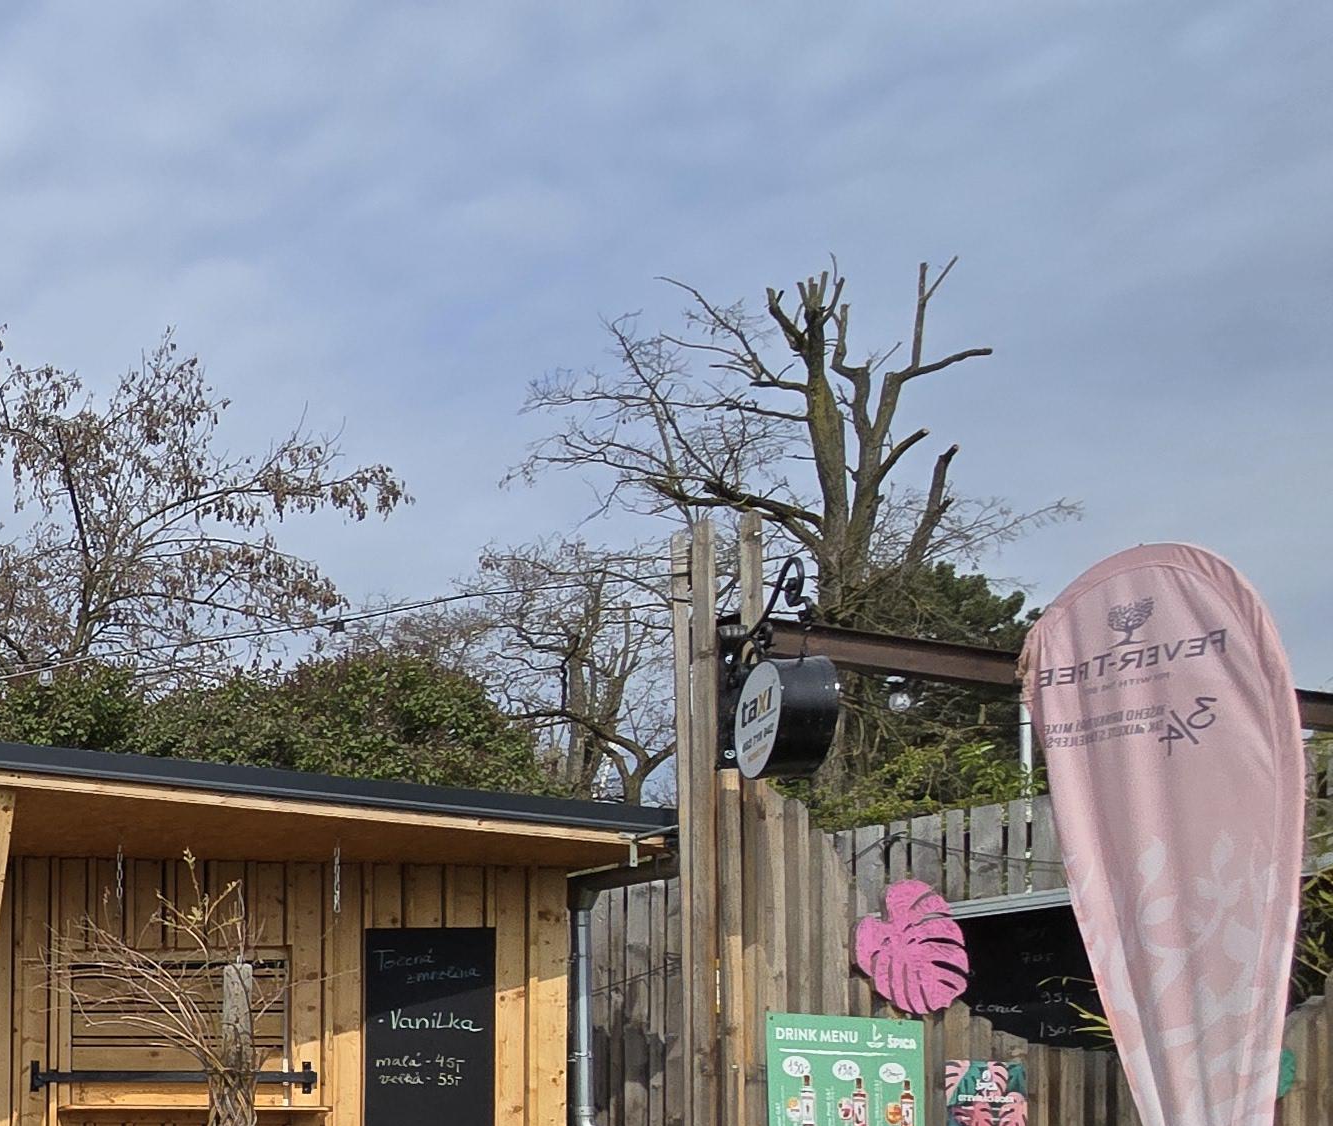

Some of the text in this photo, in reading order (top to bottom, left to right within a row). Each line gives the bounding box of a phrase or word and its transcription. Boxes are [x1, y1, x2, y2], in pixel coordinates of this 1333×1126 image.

[775, 1027, 917, 1049] DRINK MENU ŠPICA
